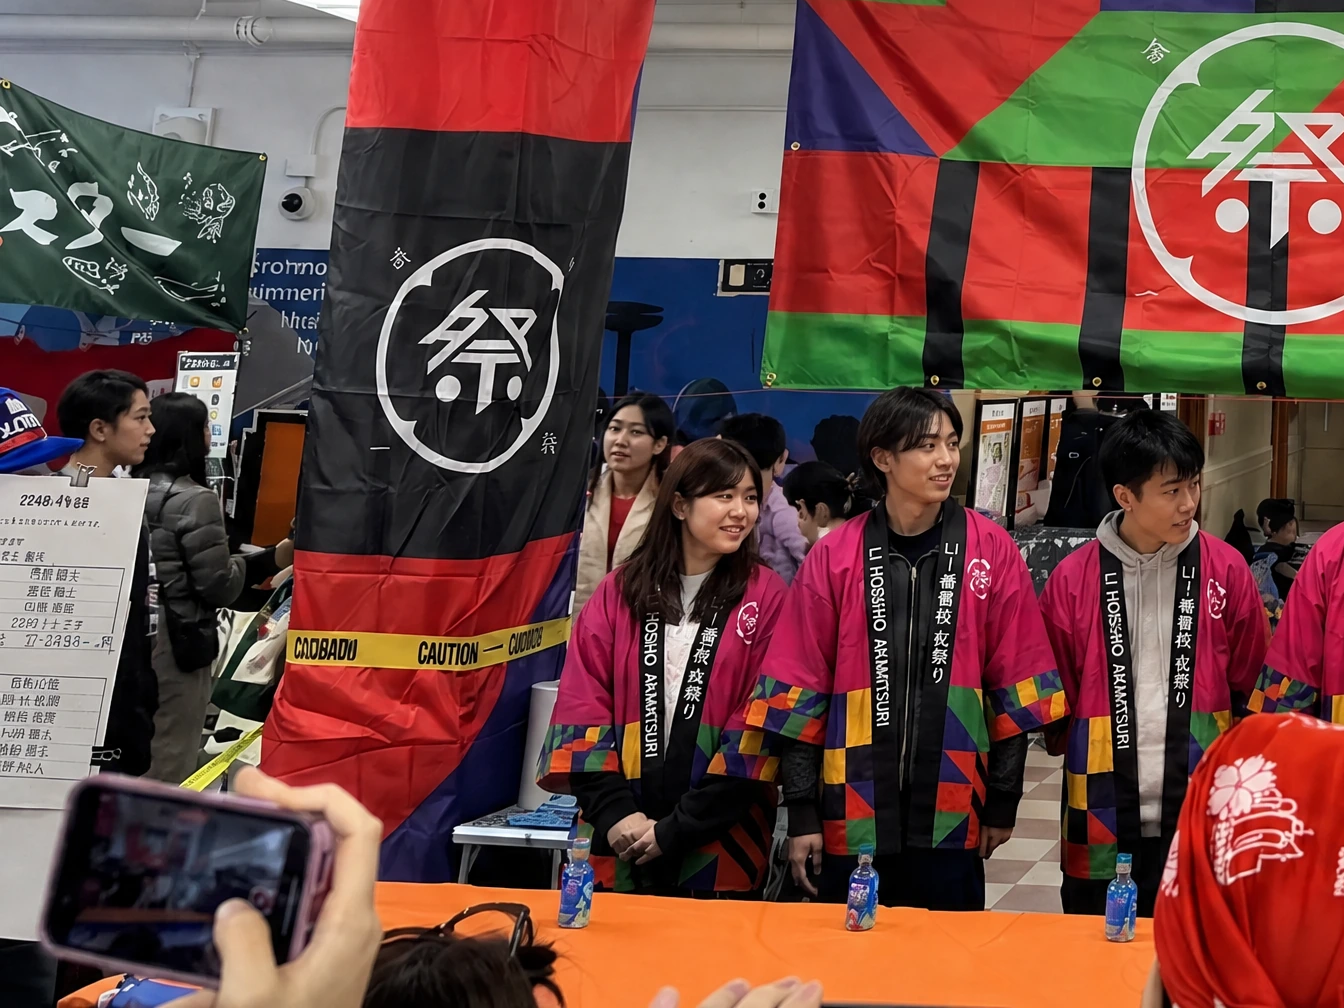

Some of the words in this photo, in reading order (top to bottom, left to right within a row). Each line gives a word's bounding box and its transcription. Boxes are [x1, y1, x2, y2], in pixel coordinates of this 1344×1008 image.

[417, 289, 538, 416] 祭
[868, 546, 883, 560] LI
[1104, 572, 1118, 585] LI
[417, 641, 479, 665] CAUTION
